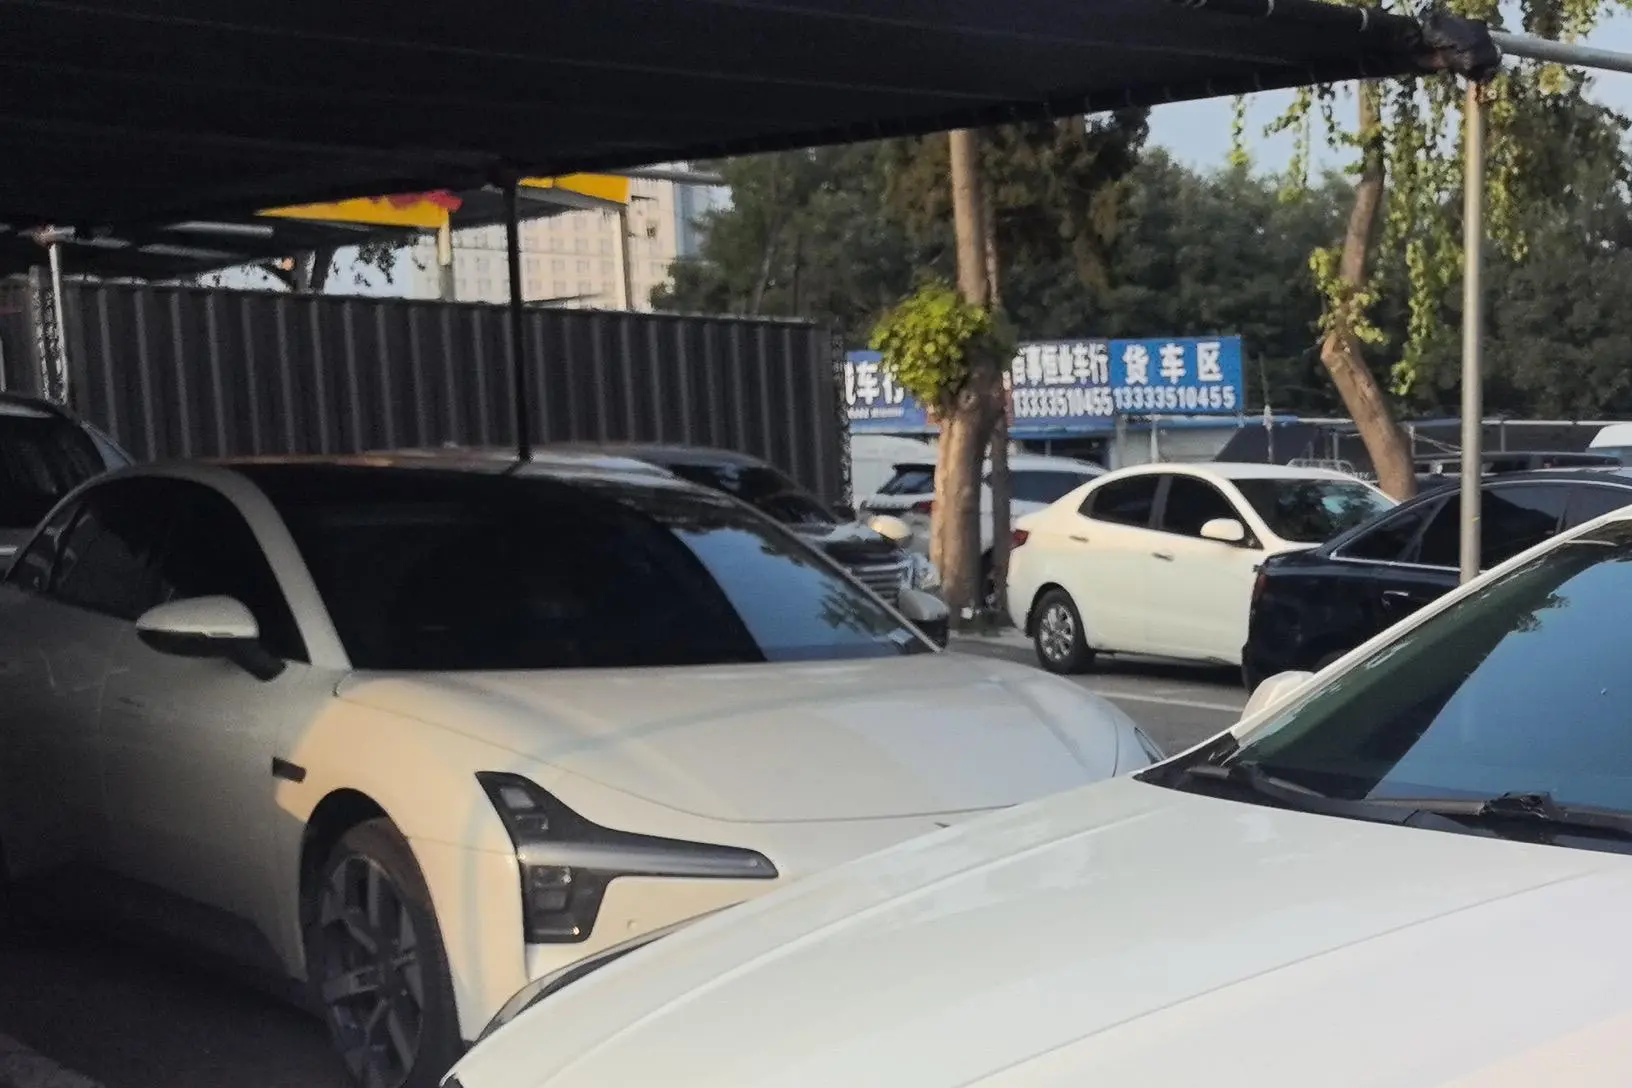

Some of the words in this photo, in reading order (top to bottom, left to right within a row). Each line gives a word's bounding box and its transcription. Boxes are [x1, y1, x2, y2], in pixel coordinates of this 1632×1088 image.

[1122, 341, 1224, 385] 货车区
[1112, 385, 1236, 409] 13333510455
